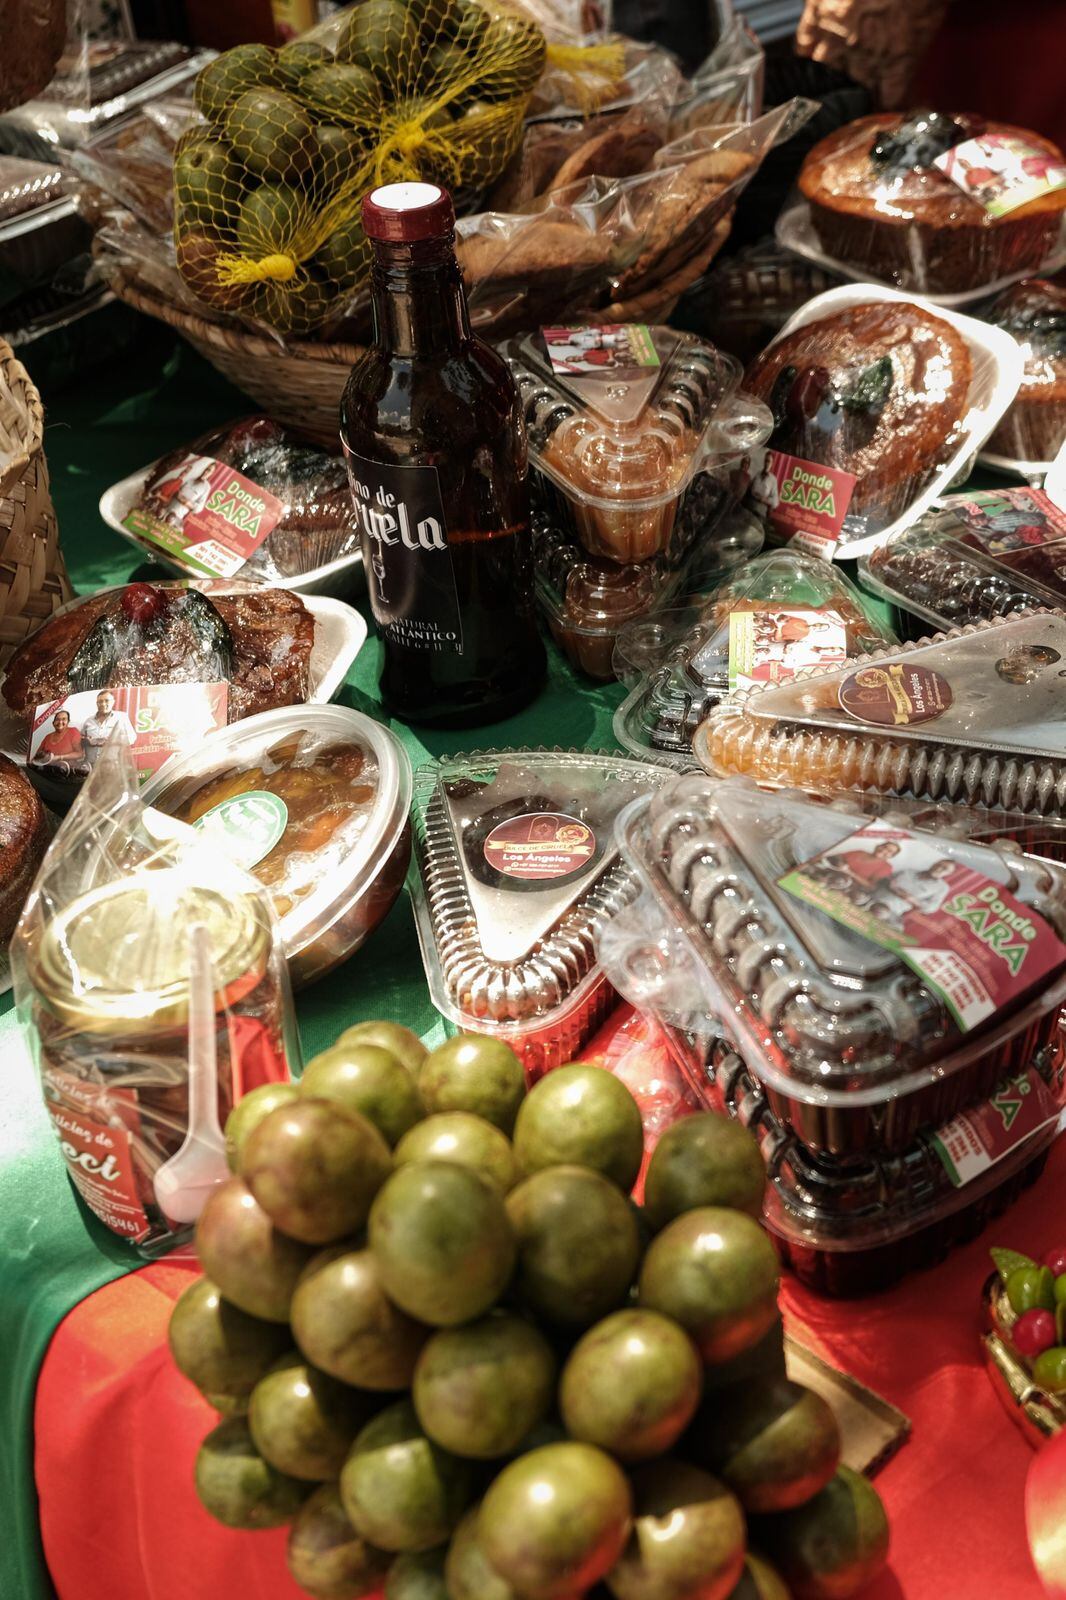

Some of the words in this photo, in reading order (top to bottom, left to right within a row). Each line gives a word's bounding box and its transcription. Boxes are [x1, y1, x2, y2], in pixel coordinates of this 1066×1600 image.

[792, 466, 833, 490] Donde
[227, 481, 266, 512] Donde
[376, 485, 396, 509] de
[780, 480, 836, 518] SARA
[206, 490, 261, 538] SARA
[390, 614, 438, 632] NATURAL
[914, 700, 926, 713] Los
[502, 853, 524, 862] Los
[976, 886, 1038, 941] Donde
[941, 892, 1029, 978] SARA
[95, 1131, 115, 1149] de
[62, 1142, 121, 1182] eci
